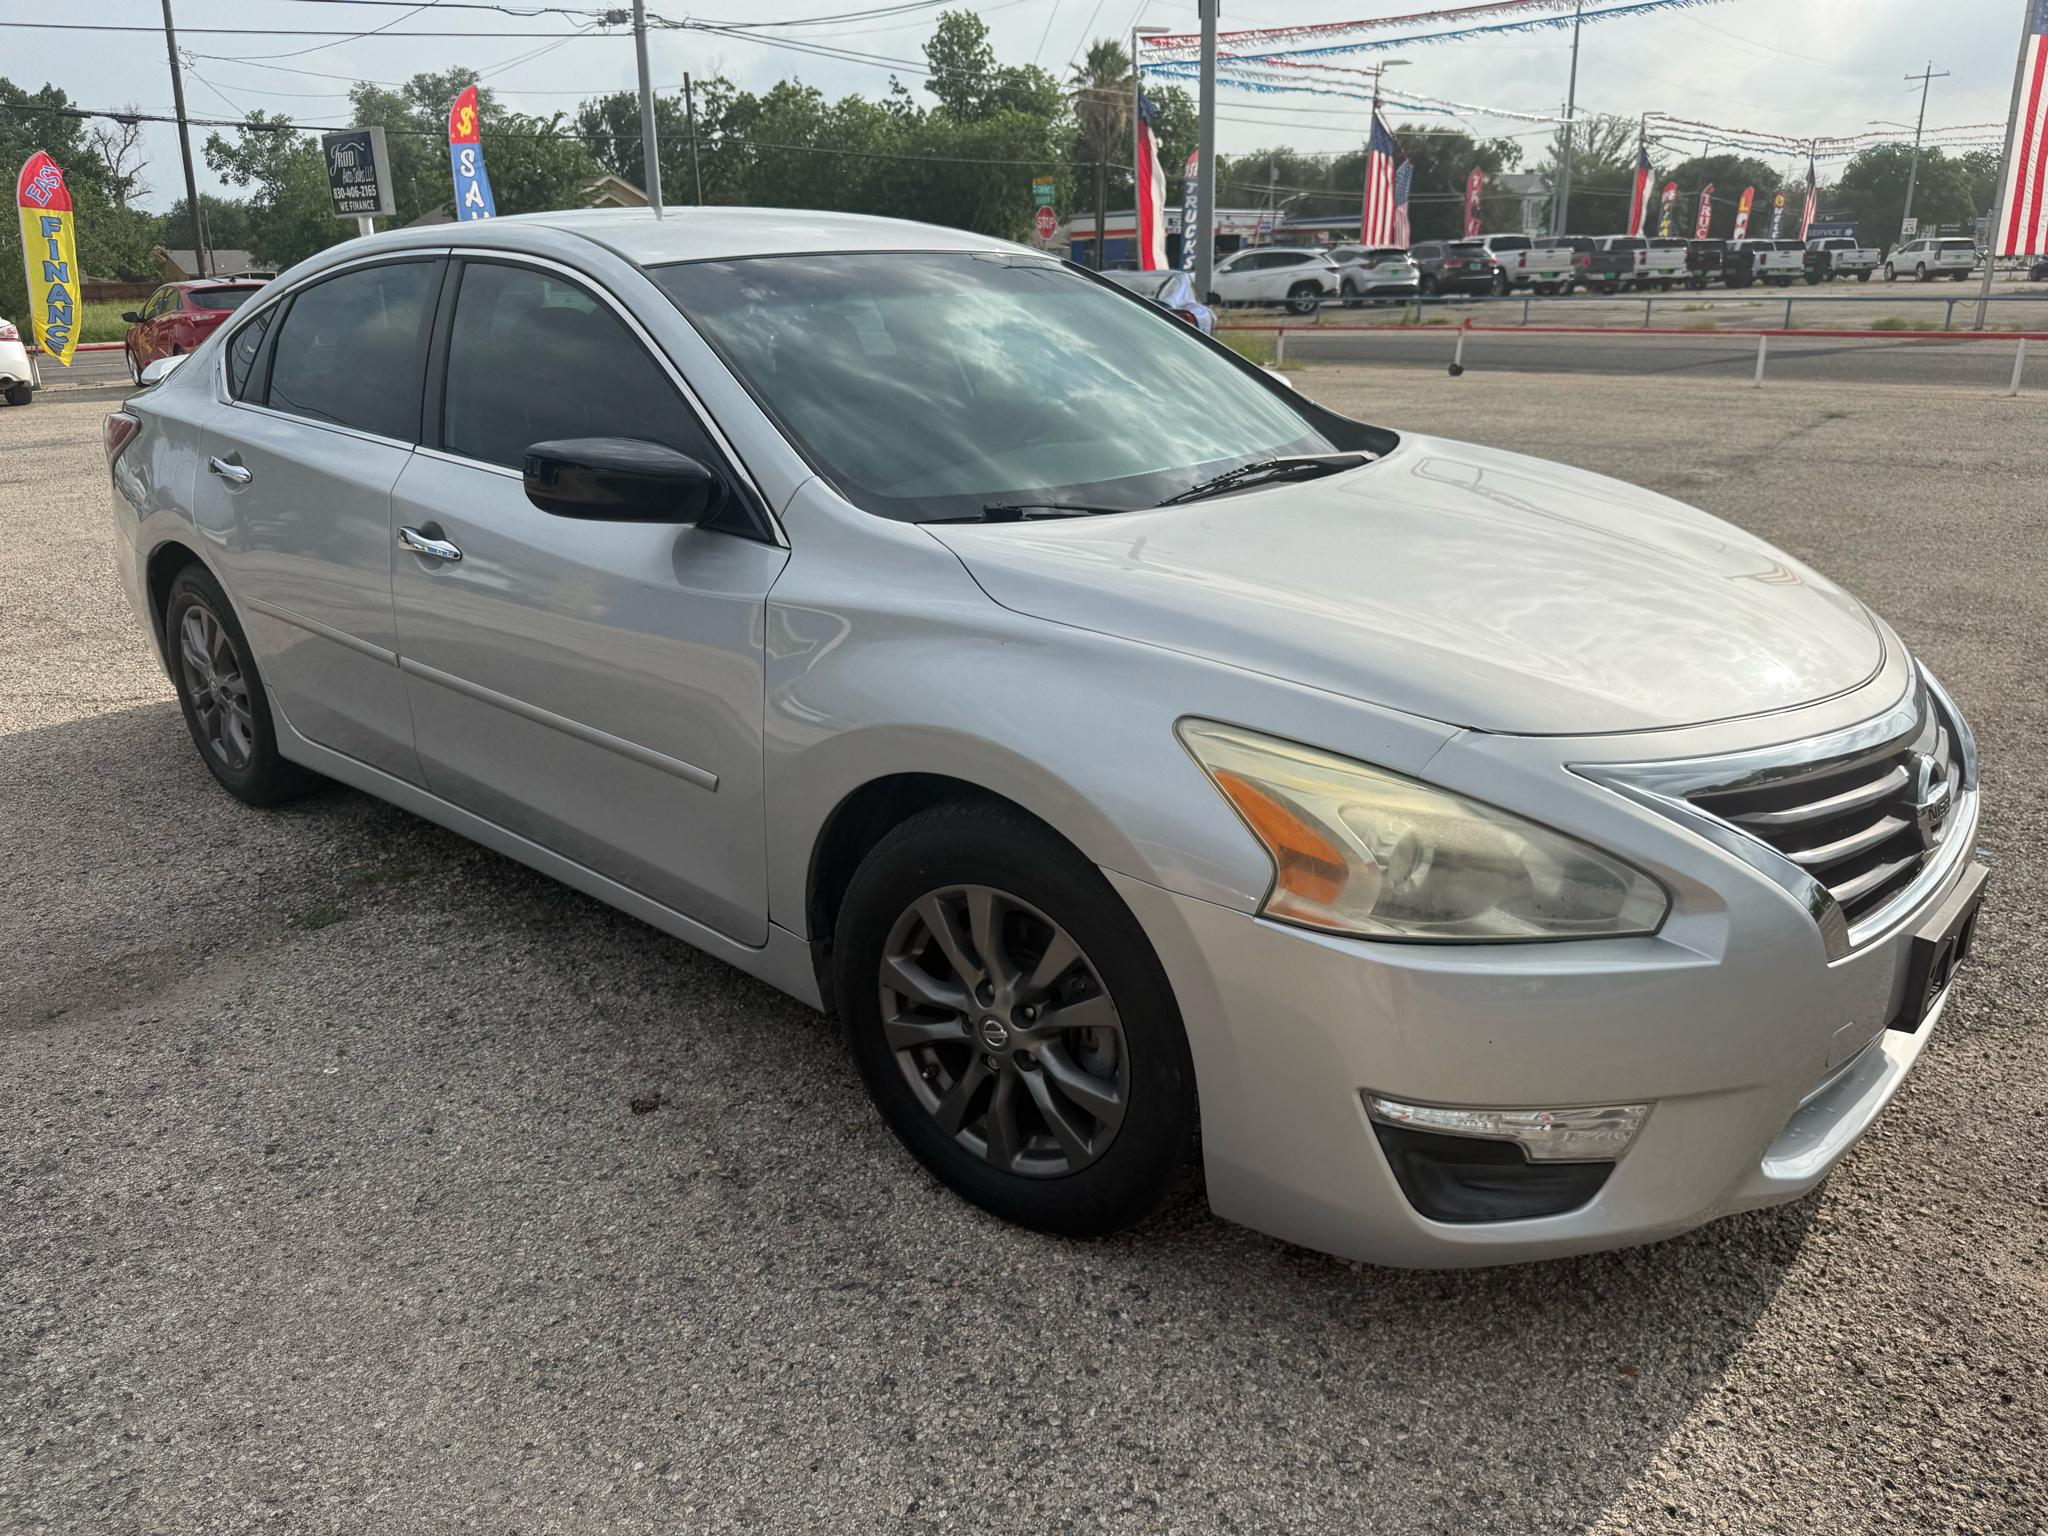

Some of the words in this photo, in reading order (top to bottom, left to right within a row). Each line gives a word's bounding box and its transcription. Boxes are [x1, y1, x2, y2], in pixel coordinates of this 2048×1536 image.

[460, 148, 490, 219] SA
[339, 201, 350, 211] WE
[349, 200, 376, 211] FINANCE
[1037, 216, 1055, 229] STOP
[1183, 182, 1198, 270] TRUCKS
[1808, 228, 1842, 237] SERVICE
